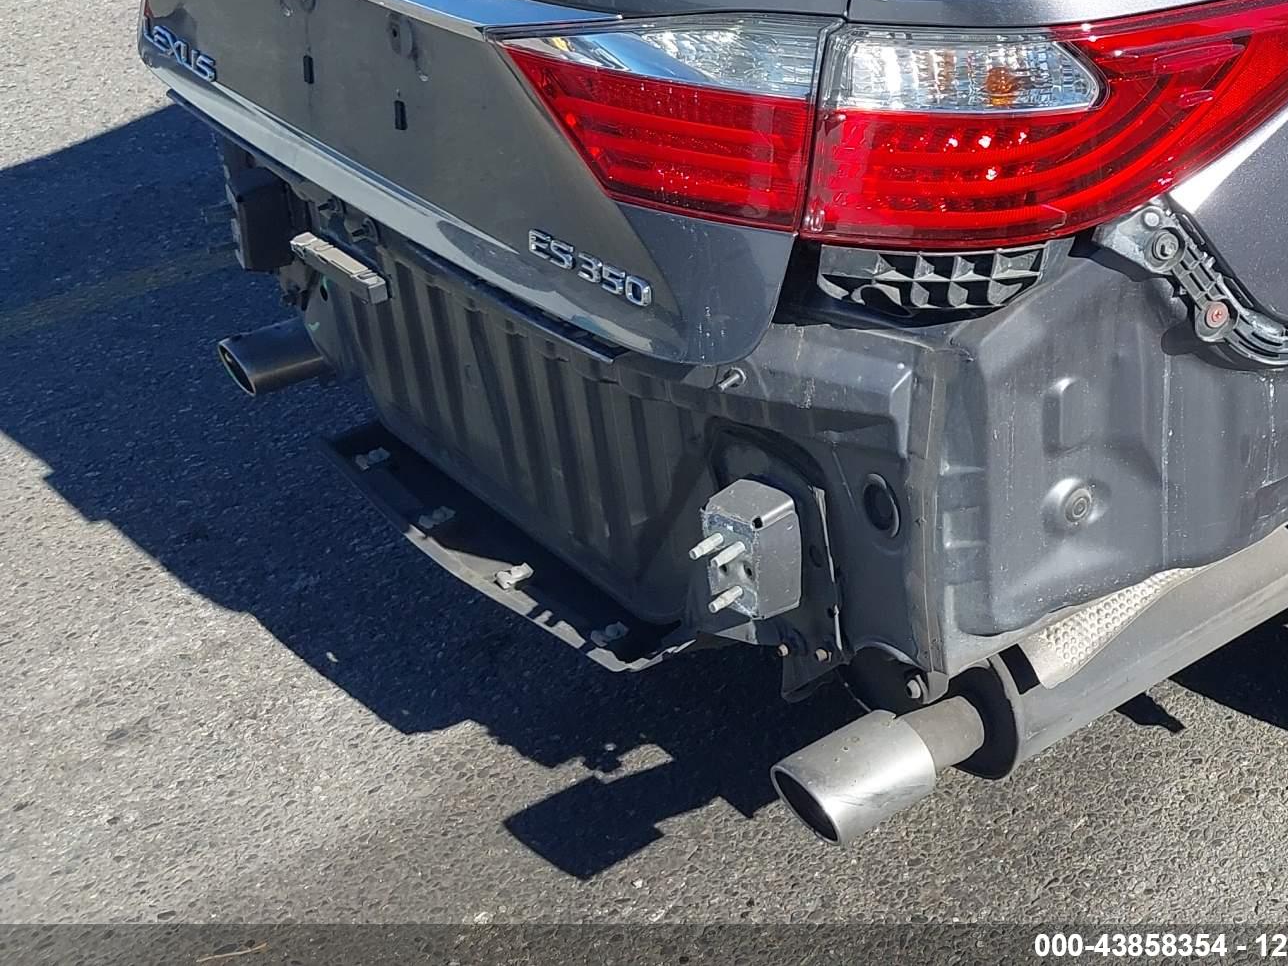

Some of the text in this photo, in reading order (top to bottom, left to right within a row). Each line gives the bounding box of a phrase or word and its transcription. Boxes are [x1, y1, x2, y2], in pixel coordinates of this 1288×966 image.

[143, 17, 216, 83] LEXUS
[528, 228, 653, 307] ES 350
